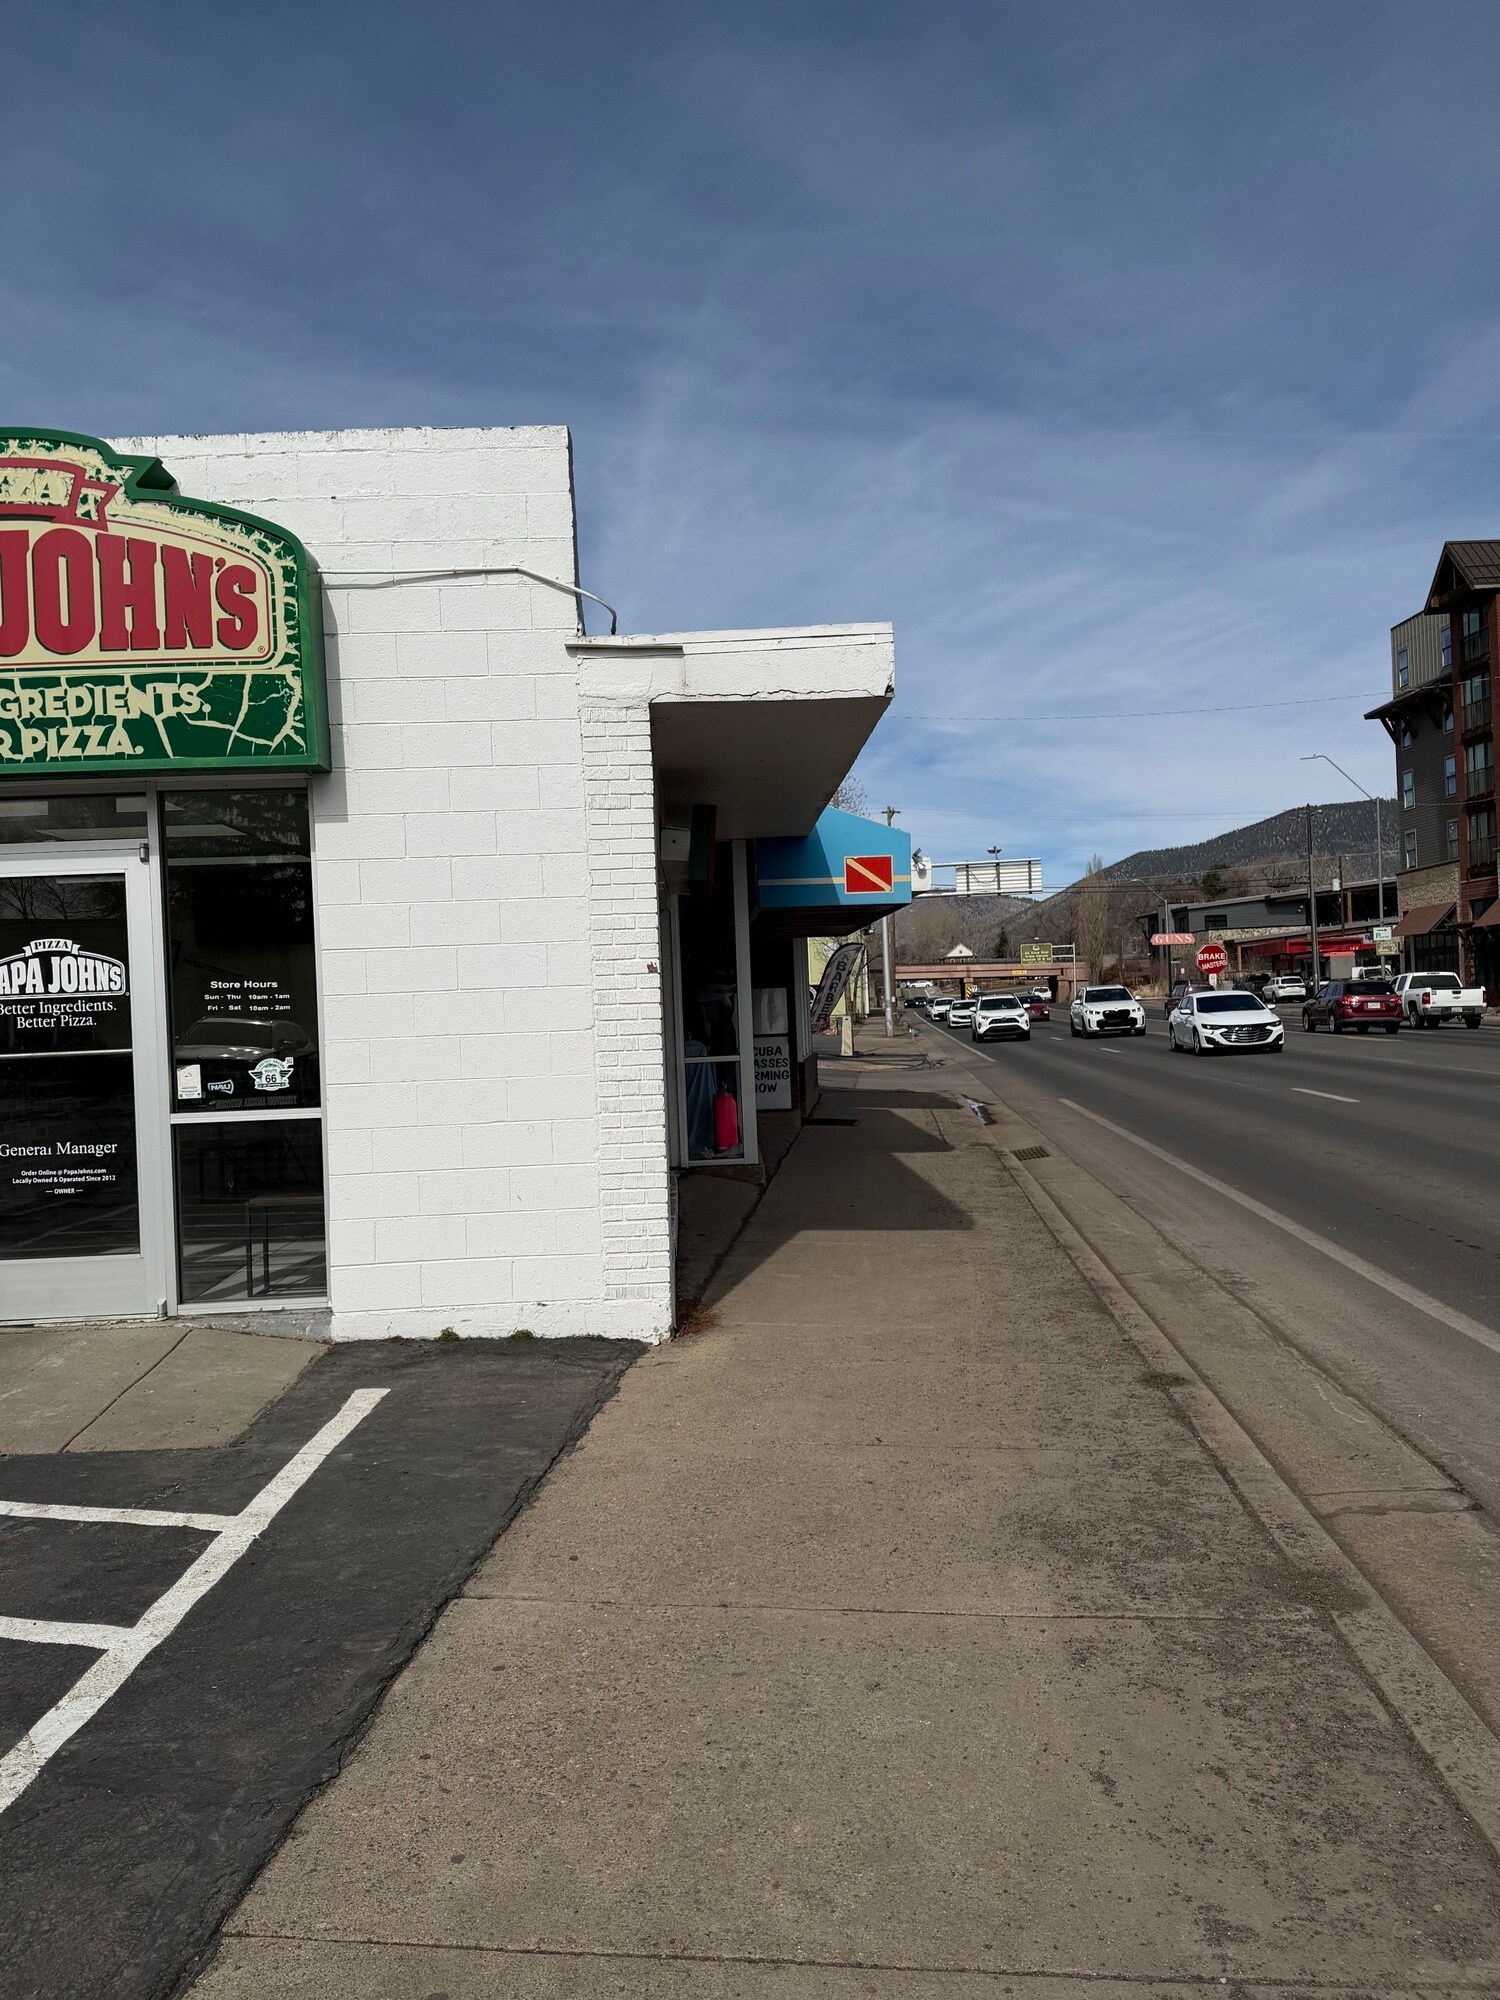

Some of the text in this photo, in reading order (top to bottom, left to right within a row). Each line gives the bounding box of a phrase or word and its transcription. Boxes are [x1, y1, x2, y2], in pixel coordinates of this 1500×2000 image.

[22, 725, 144, 757] PIZZA.
[34, 940, 69, 950] PIZZA
[1155, 934, 1192, 944] GUNS
[1202, 960, 1228, 969] MASTERS
[48, 956, 121, 993] JOHN'S
[39, 1000, 117, 1016] Ingredients.
[17, 1015, 97, 1029] Better Pizza.
[265, 1074, 277, 1083] 66
[56, 1142, 118, 1156] Manager
